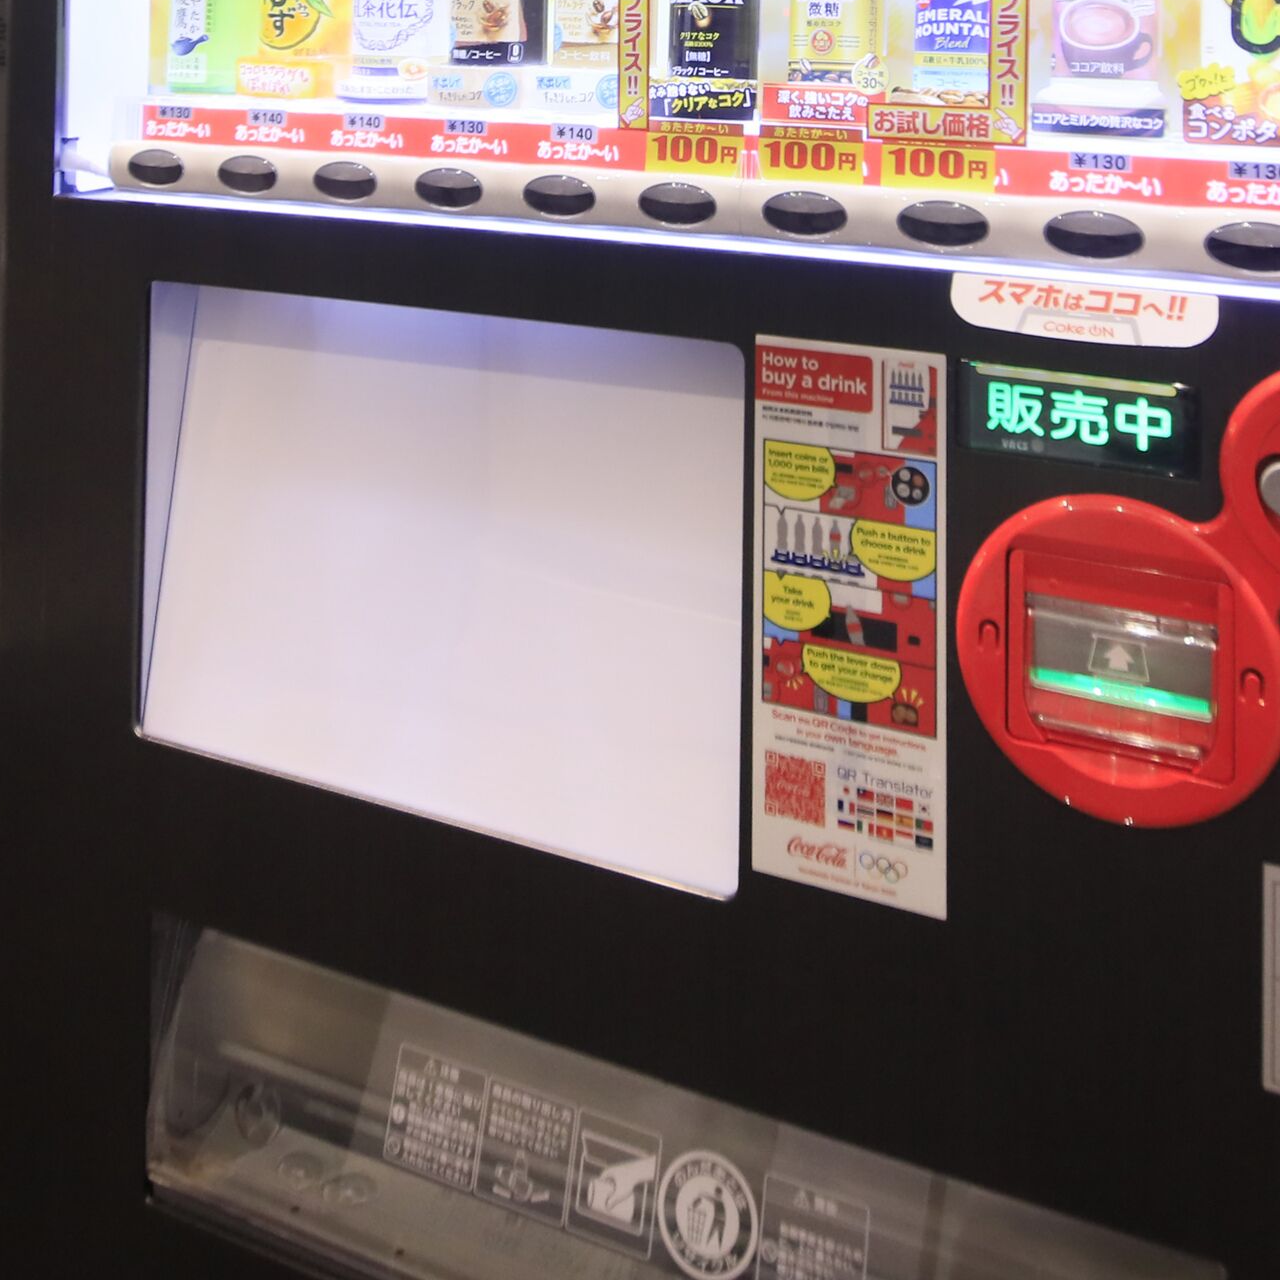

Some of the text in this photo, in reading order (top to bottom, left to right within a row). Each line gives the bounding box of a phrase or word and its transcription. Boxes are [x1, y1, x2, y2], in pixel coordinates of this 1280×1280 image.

[808, 2, 840, 17] 微糖
[934, 37, 970, 50] Blend
[1070, 61, 1124, 74] ココア飲料
[160, 106, 190, 118] ¥130
[251, 112, 283, 124] ¥140
[788, 105, 854, 121] 飲みごたえ
[1188, 103, 1236, 120] 食べる
[348, 116, 380, 128] ¥140
[447, 121, 484, 133] ¥130
[874, 110, 990, 138] お試し価格
[1033, 112, 1163, 130] ココアとミルクの贅沢なコク
[557, 127, 593, 141] ¥140
[1188, 118, 1278, 143] コンポタ
[652, 136, 737, 164] 100円
[764, 141, 857, 171] 100円
[888, 148, 987, 180] 100円
[1074, 153, 1126, 171] ¥130
[978, 278, 1189, 321] スマホはココへ!!
[1043, 320, 1114, 339] Coke ON
[762, 352, 819, 371] How to
[762, 367, 867, 395] buy a drink
[762, 388, 834, 403] From this machine
[986, 381, 1172, 452] 販売中
[769, 450, 792, 459] Insert
[794, 453, 817, 462] coins
[794, 463, 810, 473] yen
[812, 464, 829, 475] bills
[857, 527, 878, 539] Push
[888, 531, 918, 544] button
[903, 545, 926, 557] drink
[783, 586, 802, 596] Take
[771, 595, 814, 609] your drink
[807, 648, 829, 660] Push
[831, 652, 844, 663] the
[837, 767, 933, 799] QR Translator
